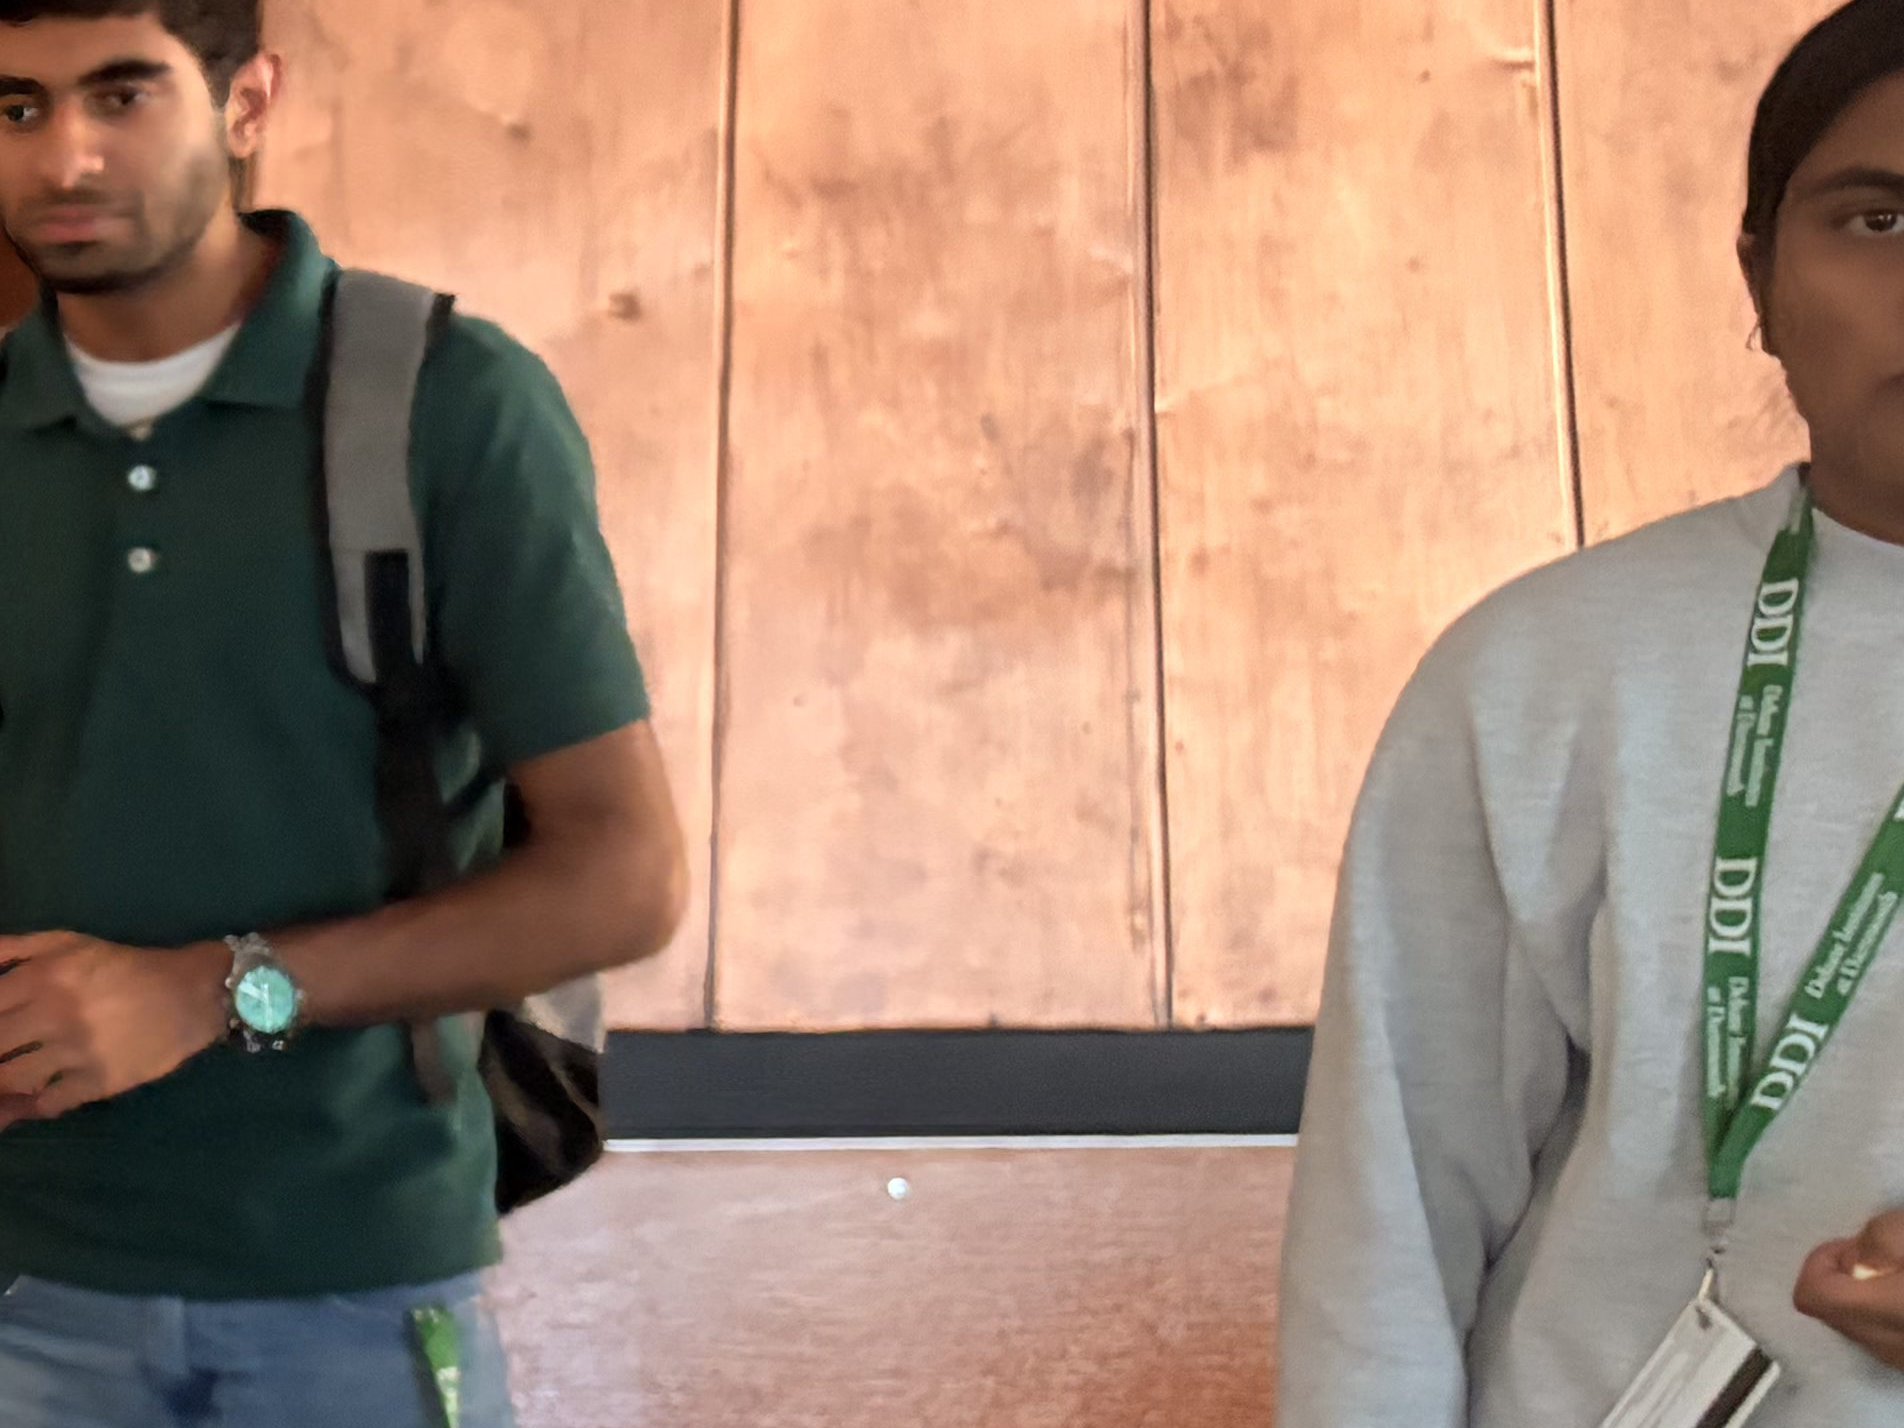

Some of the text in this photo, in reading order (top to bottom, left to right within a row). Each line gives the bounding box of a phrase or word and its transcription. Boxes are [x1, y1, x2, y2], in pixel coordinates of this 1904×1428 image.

[1747, 577, 1799, 667] DDI
[1708, 856, 1758, 958] DDI
[1750, 1014, 1829, 1109] DDI
